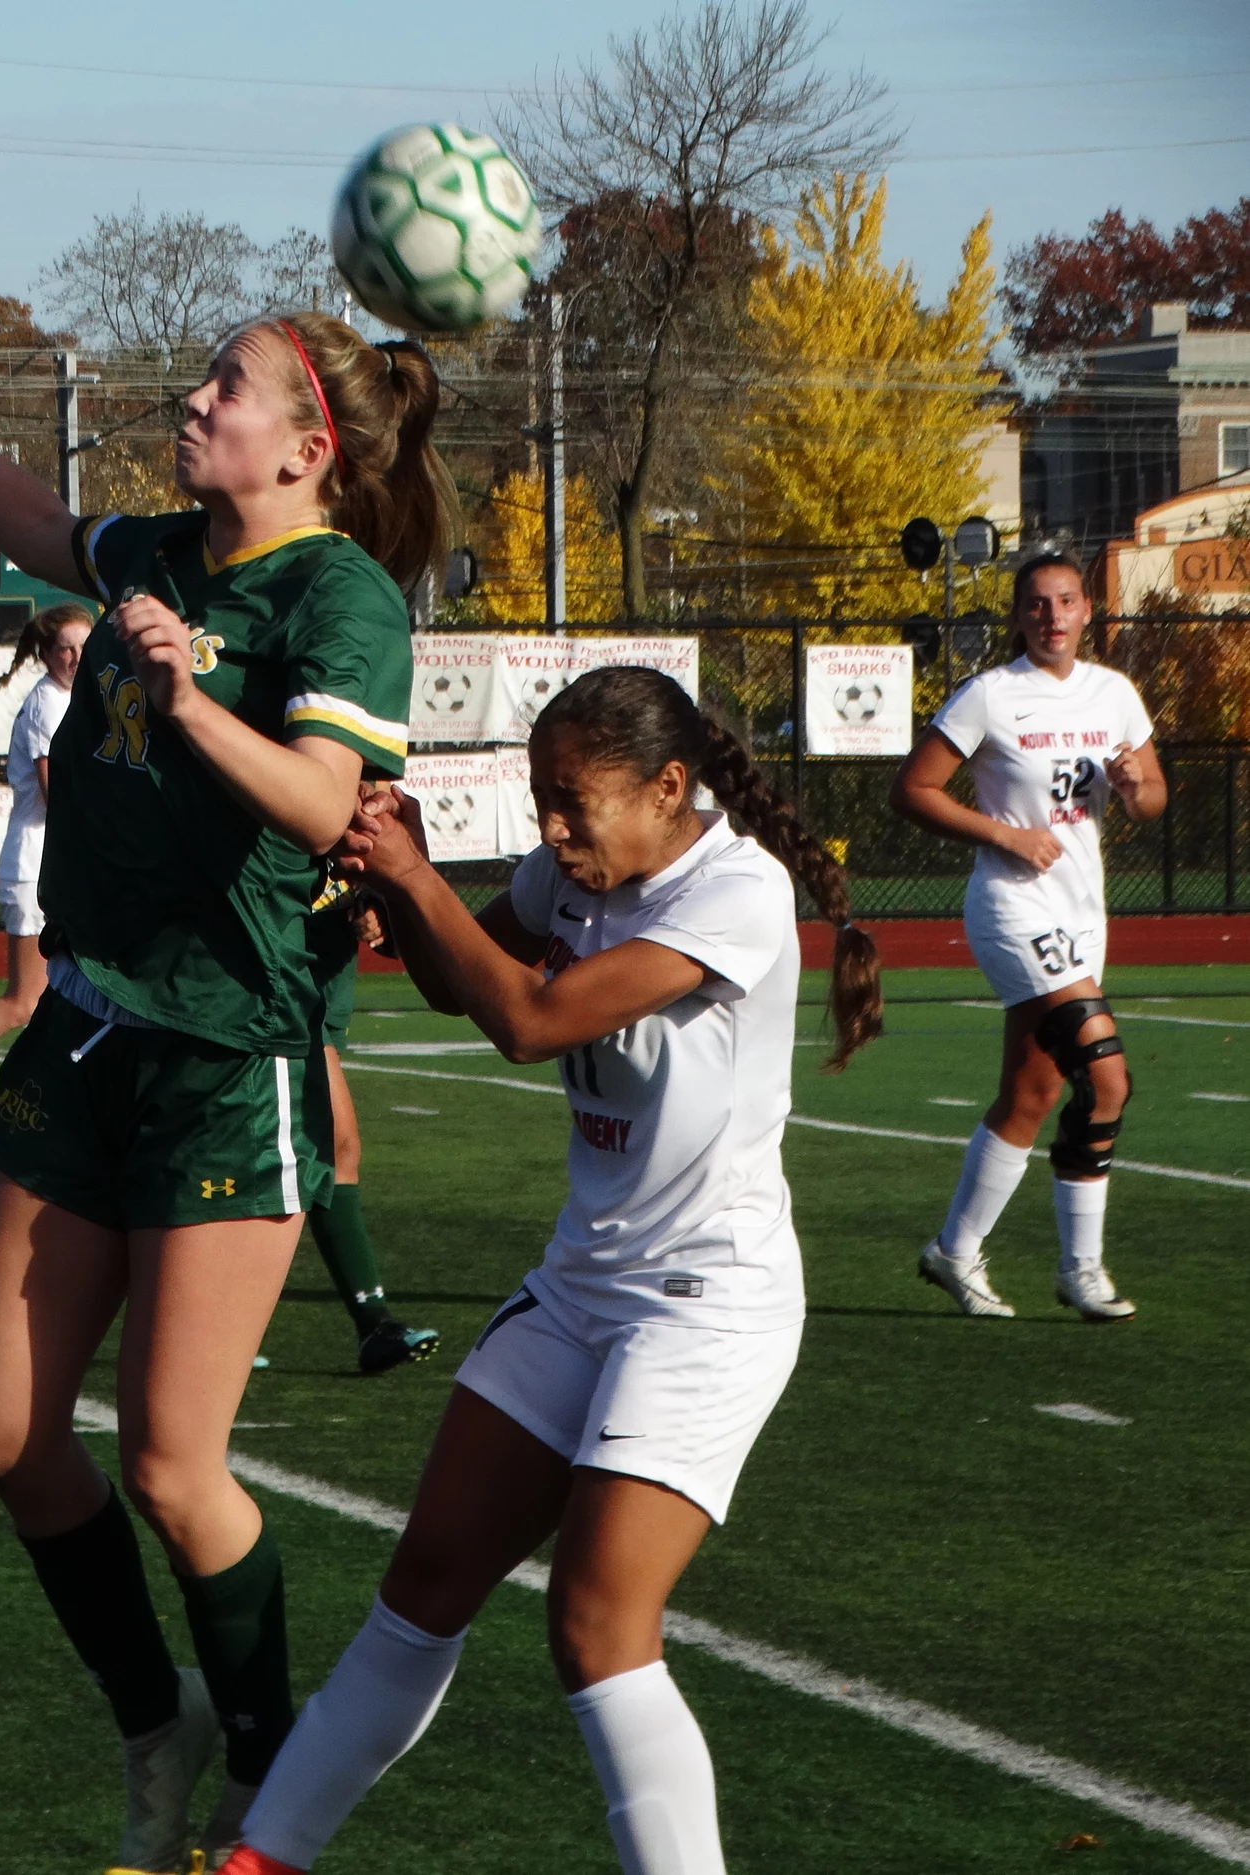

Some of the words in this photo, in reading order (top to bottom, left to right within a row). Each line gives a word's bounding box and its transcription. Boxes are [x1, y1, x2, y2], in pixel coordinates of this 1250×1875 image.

[433, 639, 474, 650] BANK
[480, 643, 497, 655] FC
[500, 642, 528, 655] RED
[533, 640, 575, 651] BANK
[632, 640, 673, 651] BANK
[506, 655, 591, 669] WOLVES
[605, 656, 691, 669] WOLVES
[810, 650, 839, 665] RED
[844, 648, 885, 658] BANK
[891, 652, 908, 665] FC
[827, 662, 892, 676] SHARKS
[1018, 732, 1057, 751] MOUNT
[1062, 731, 1075, 748] ST
[1081, 730, 1109, 748] MARY
[433, 759, 474, 770] BANK
[480, 762, 497, 773] FC
[405, 774, 497, 789] WARRIORS
[1051, 756, 1095, 803] 52
[1030, 928, 1083, 976] 52
